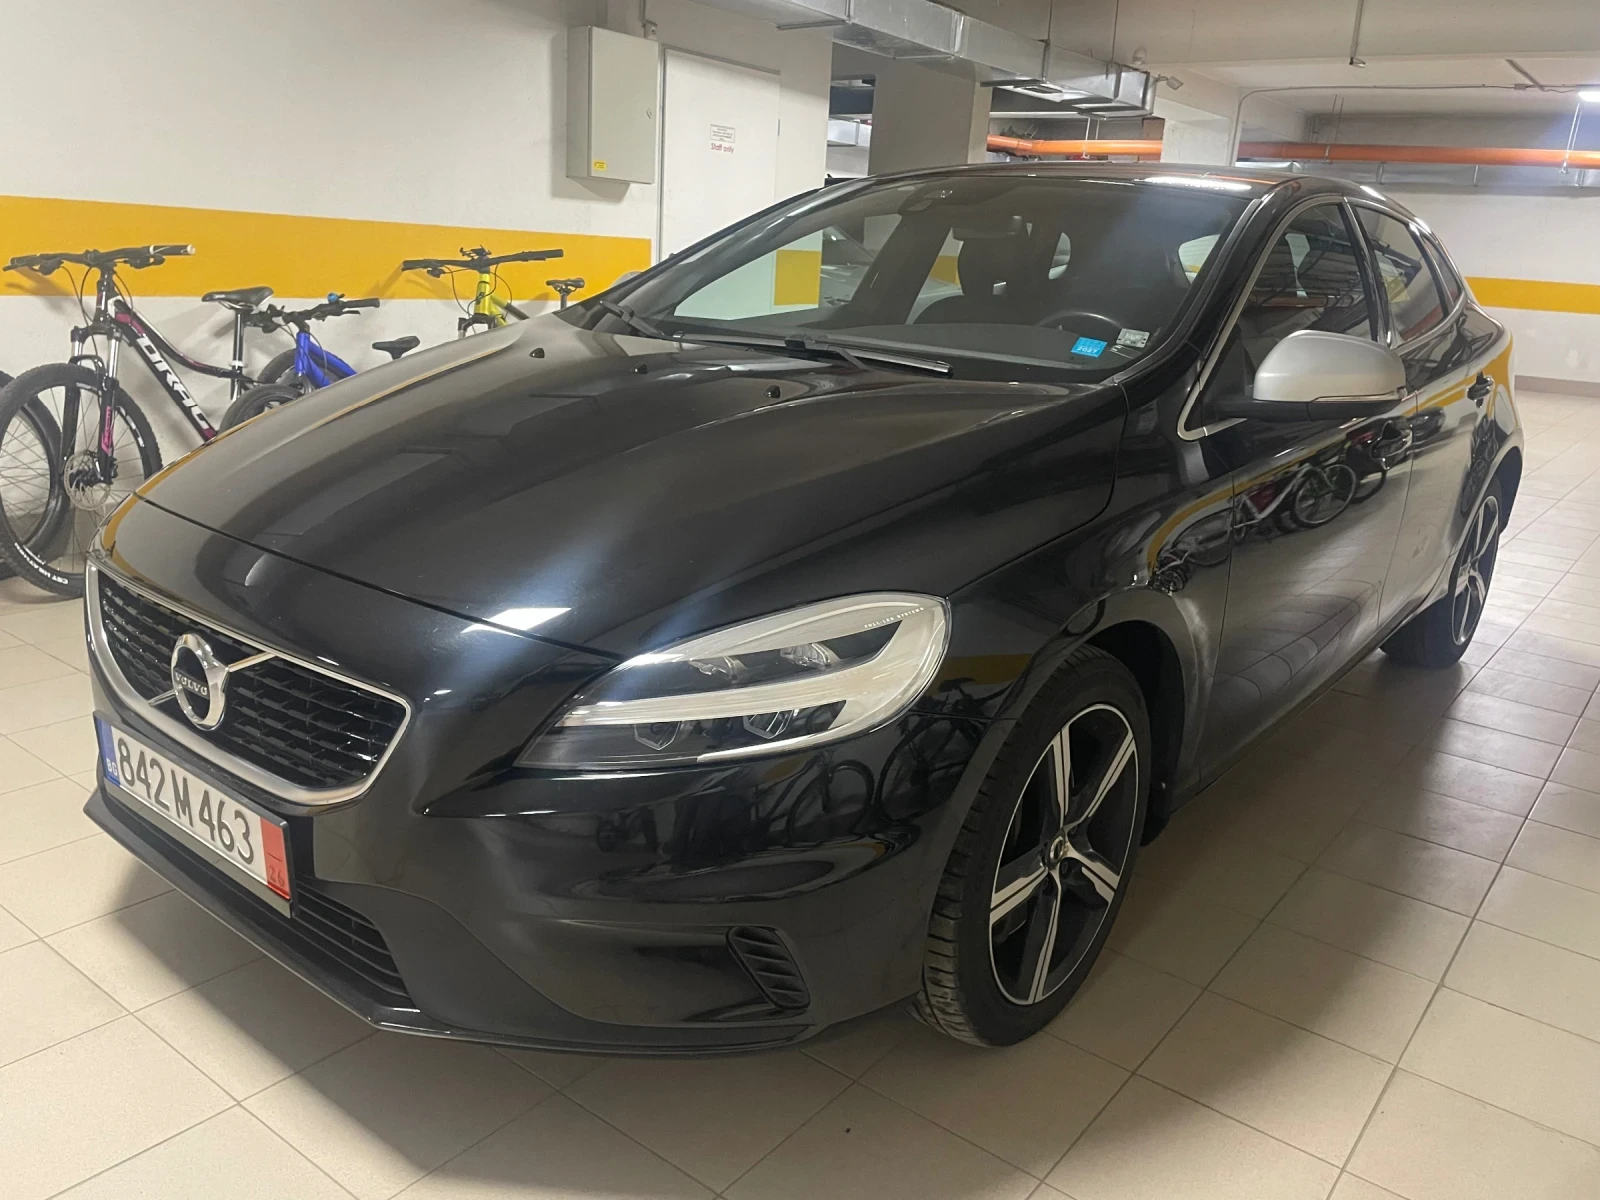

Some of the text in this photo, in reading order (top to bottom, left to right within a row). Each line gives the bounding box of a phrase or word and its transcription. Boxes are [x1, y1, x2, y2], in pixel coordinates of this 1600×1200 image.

[136, 334, 211, 430] DRAG
[51, 574, 69, 585] CST
[175, 672, 208, 696] VOLVO
[106, 757, 118, 776] BG
[117, 737, 254, 865] 842 M 463
[269, 866, 286, 888] 26
